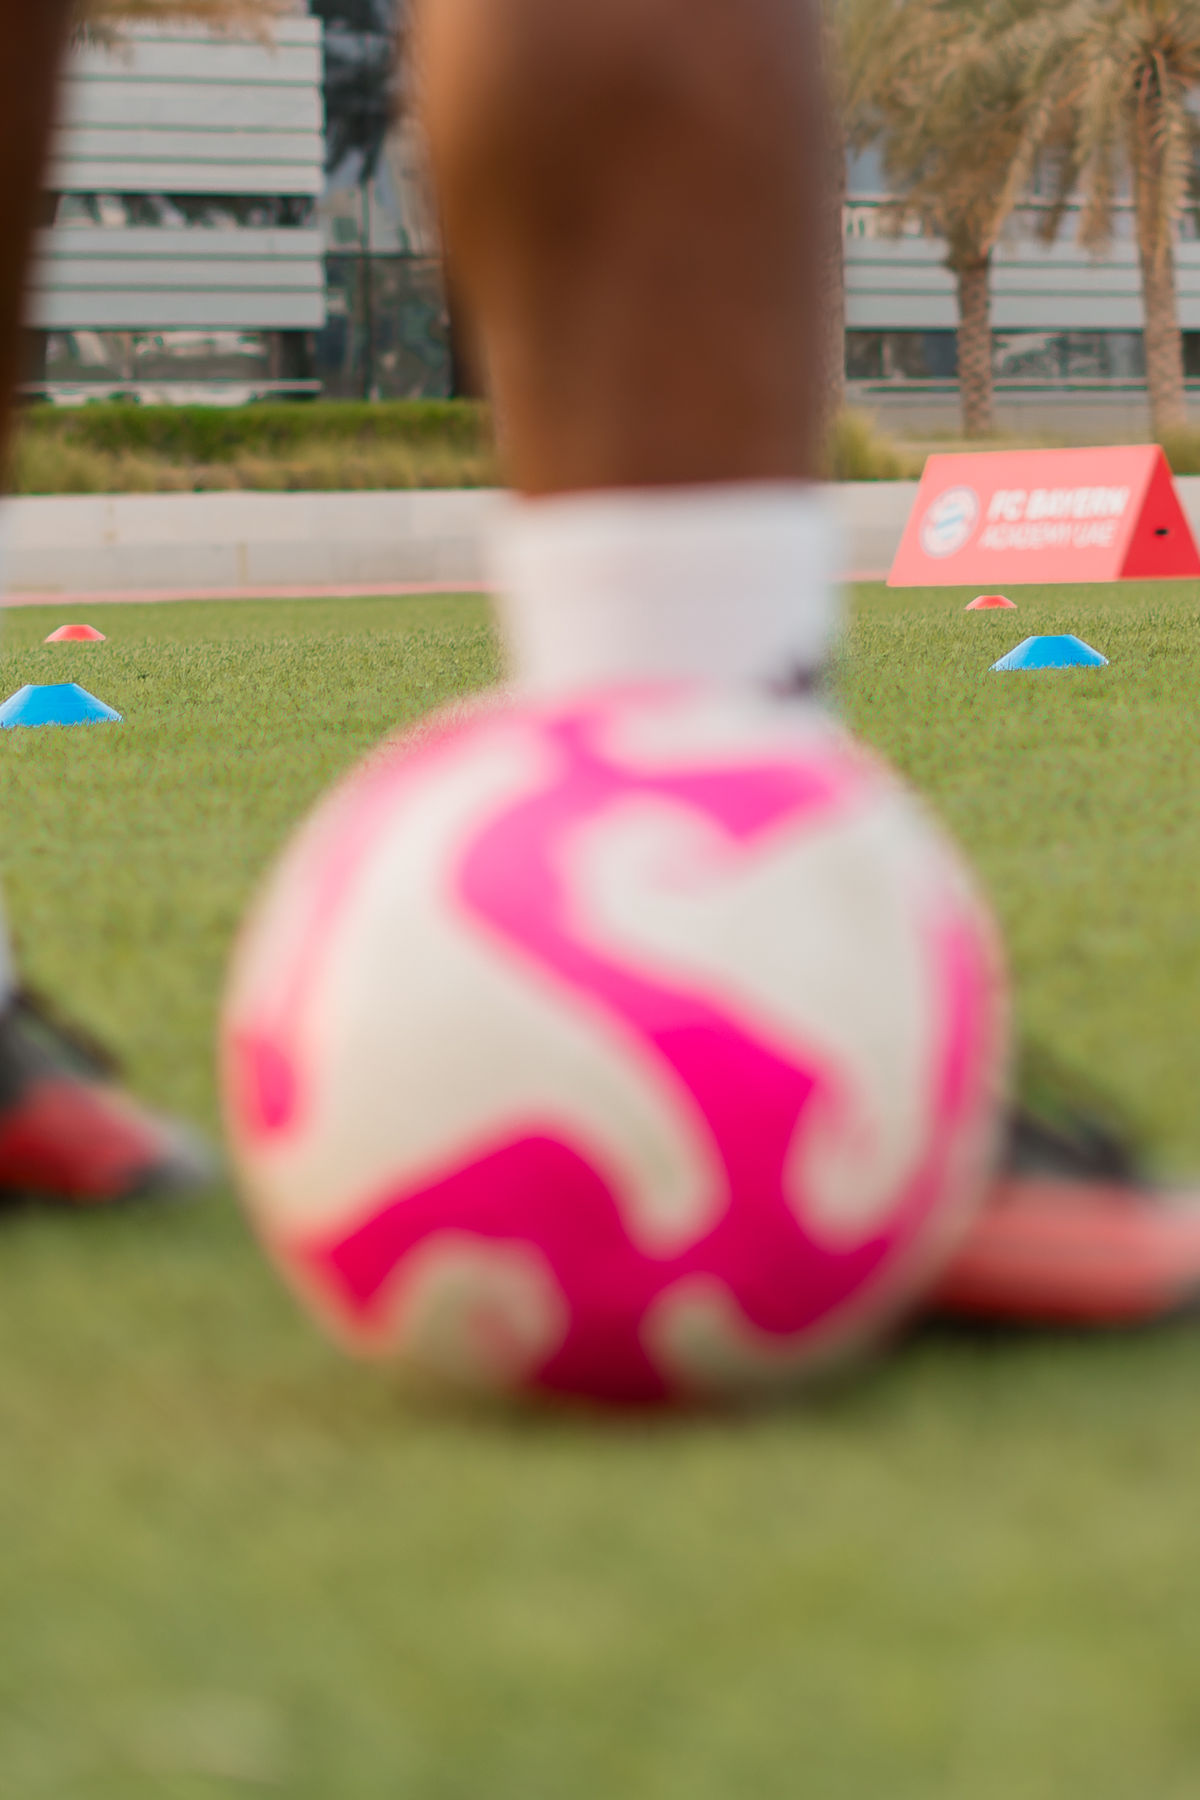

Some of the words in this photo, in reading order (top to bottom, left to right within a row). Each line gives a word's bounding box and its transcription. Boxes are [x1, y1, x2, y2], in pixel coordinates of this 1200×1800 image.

[988, 489, 1025, 519] FC
[1026, 487, 1130, 518] BAYERN
[980, 522, 1072, 550] ACADEMY
